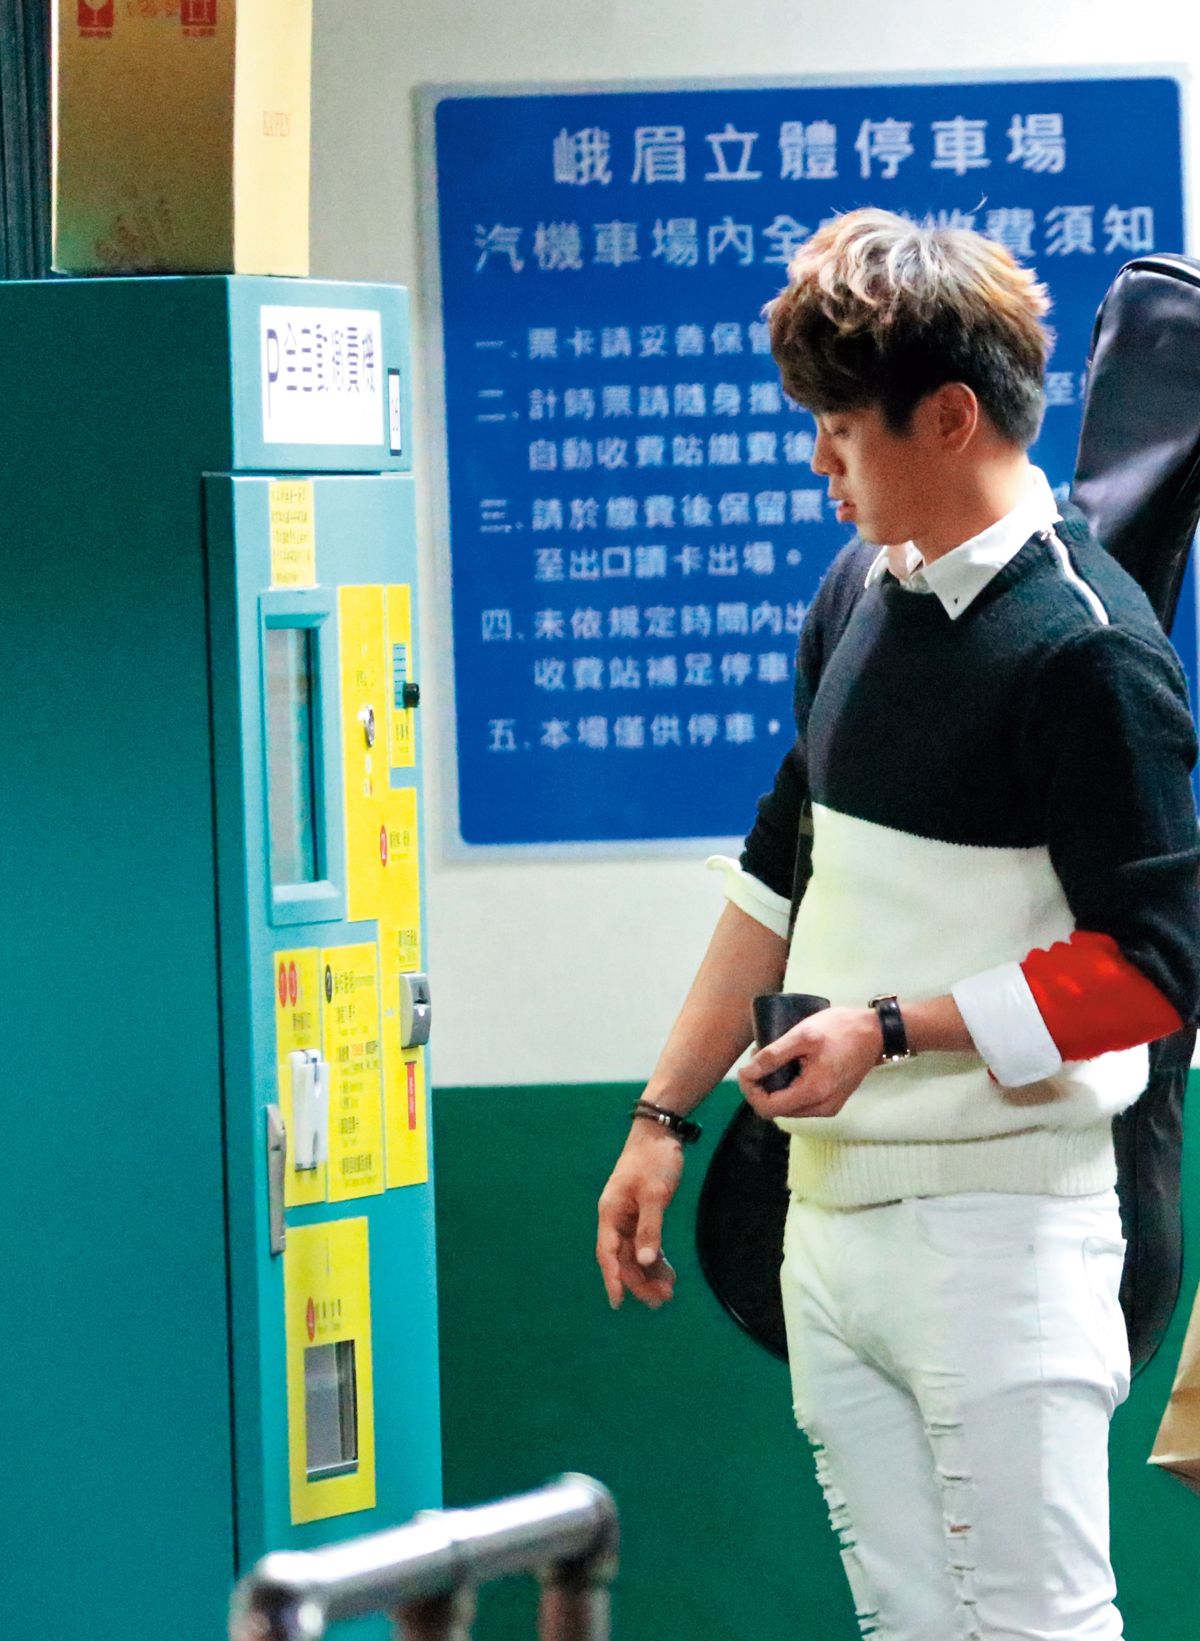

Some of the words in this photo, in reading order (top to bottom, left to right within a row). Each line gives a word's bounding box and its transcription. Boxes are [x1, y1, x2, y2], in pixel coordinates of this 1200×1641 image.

[552, 112, 1067, 187] 峨眉立體停車場
[479, 488, 843, 533] 三、請於繳費後保留票
